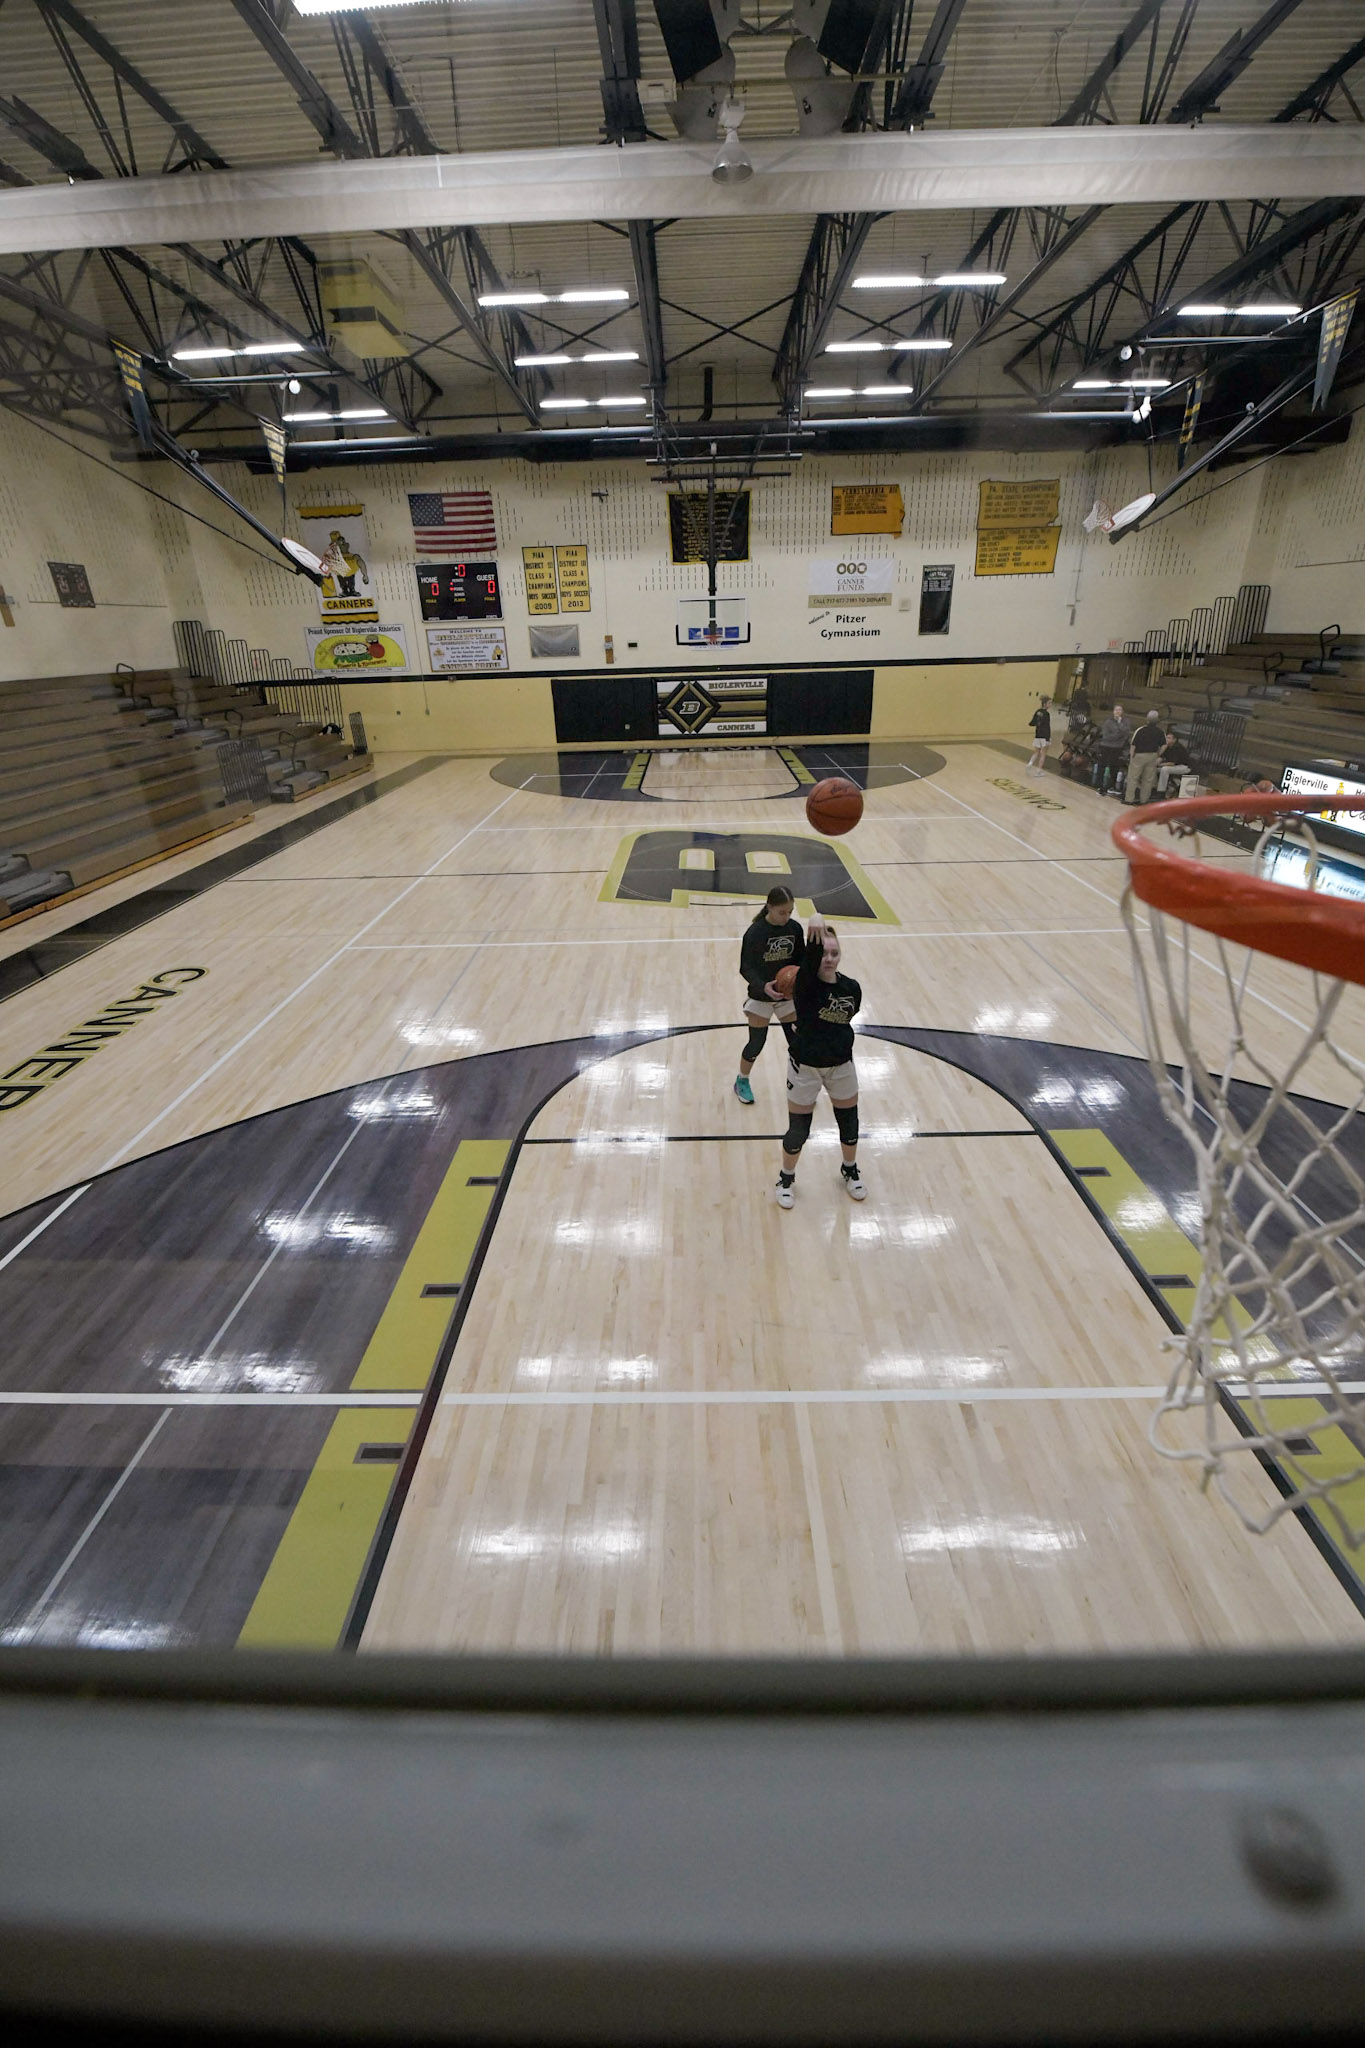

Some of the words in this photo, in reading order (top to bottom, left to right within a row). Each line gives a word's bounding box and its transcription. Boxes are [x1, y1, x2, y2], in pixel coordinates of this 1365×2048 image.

[420, 576, 439, 584] HOME
[431, 583, 440, 596] 0
[487, 580, 496, 594] 0
[326, 599, 374, 610] CANNERS
[836, 614, 867, 624] Pitzer
[352, 626, 378, 635] Biglerville
[378, 625, 402, 633] Athletics
[820, 627, 881, 640] Gymnasium
[708, 681, 764, 689] BIGLERVILLE
[1284, 769, 1329, 791] Biglerville
